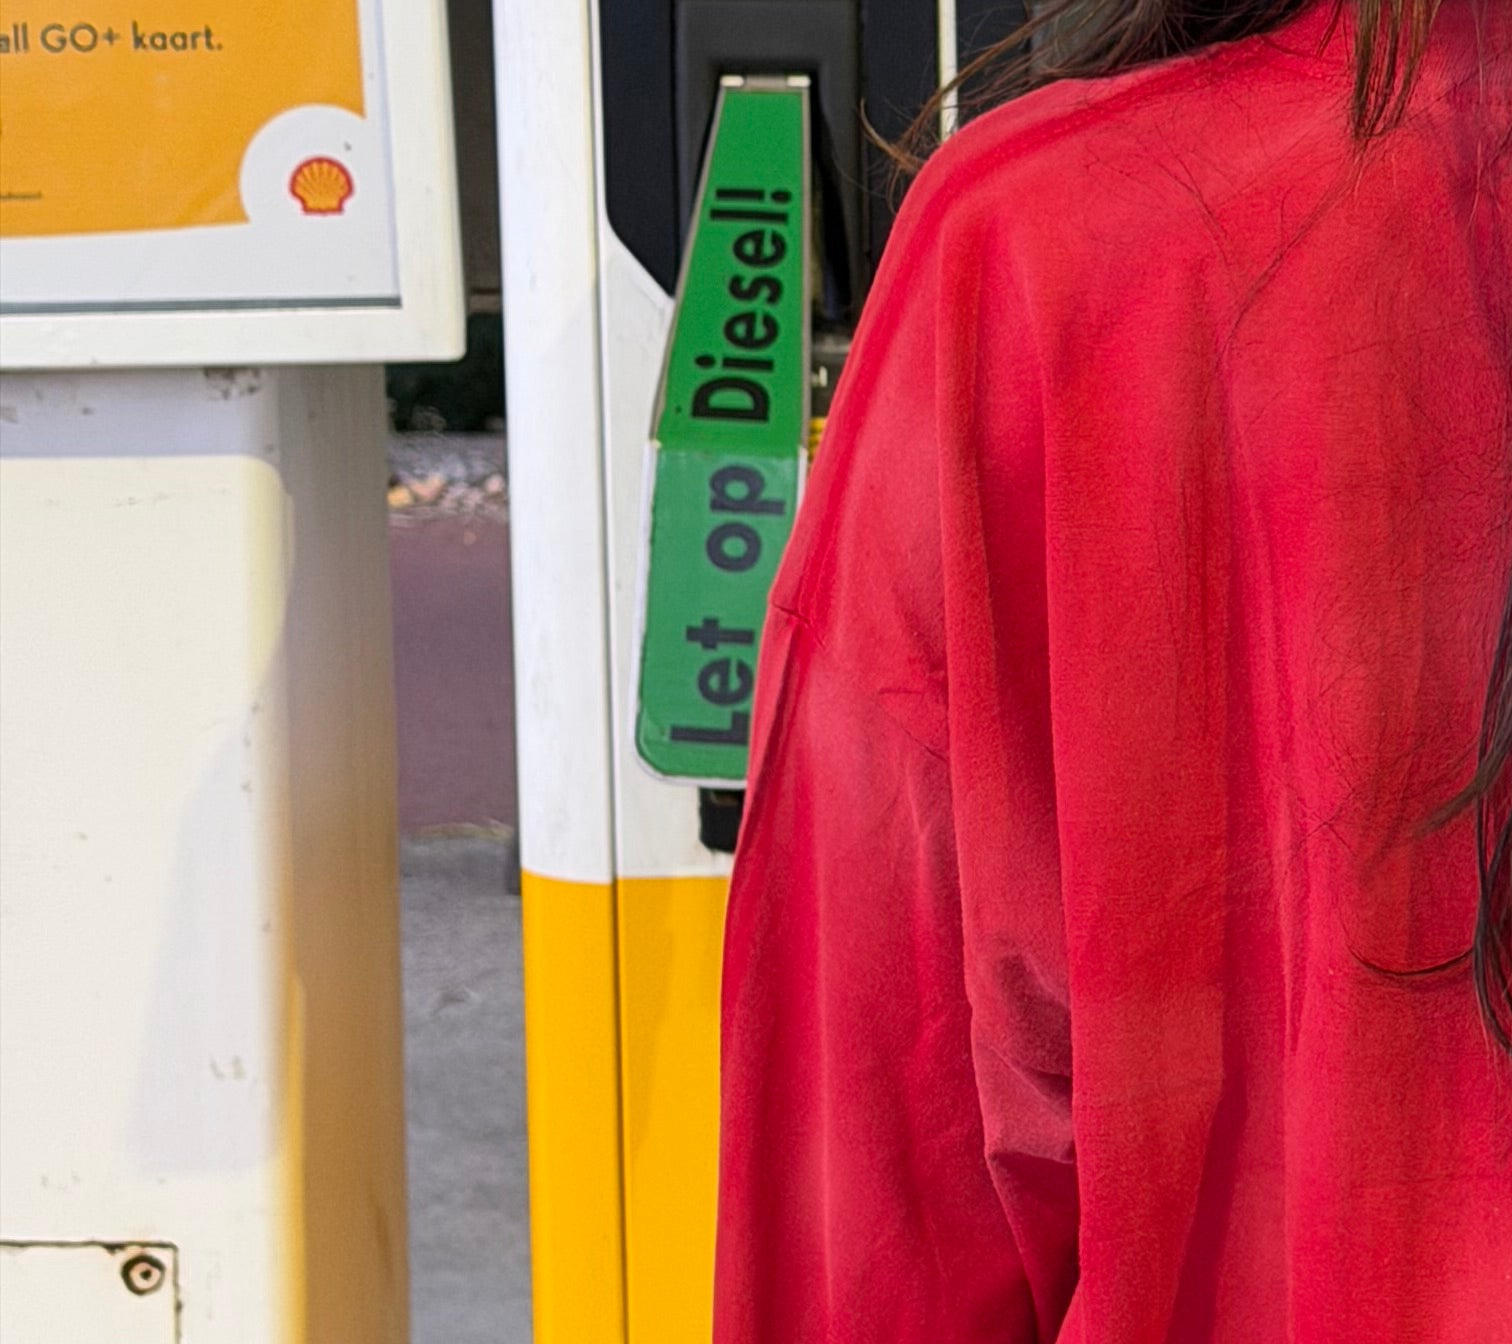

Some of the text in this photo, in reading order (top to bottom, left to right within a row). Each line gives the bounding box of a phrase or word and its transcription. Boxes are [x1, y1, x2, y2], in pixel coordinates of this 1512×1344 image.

[40, 22, 121, 53] GO+
[131, 19, 224, 52] kaart.
[668, 186, 793, 747] Let op Diesel!
